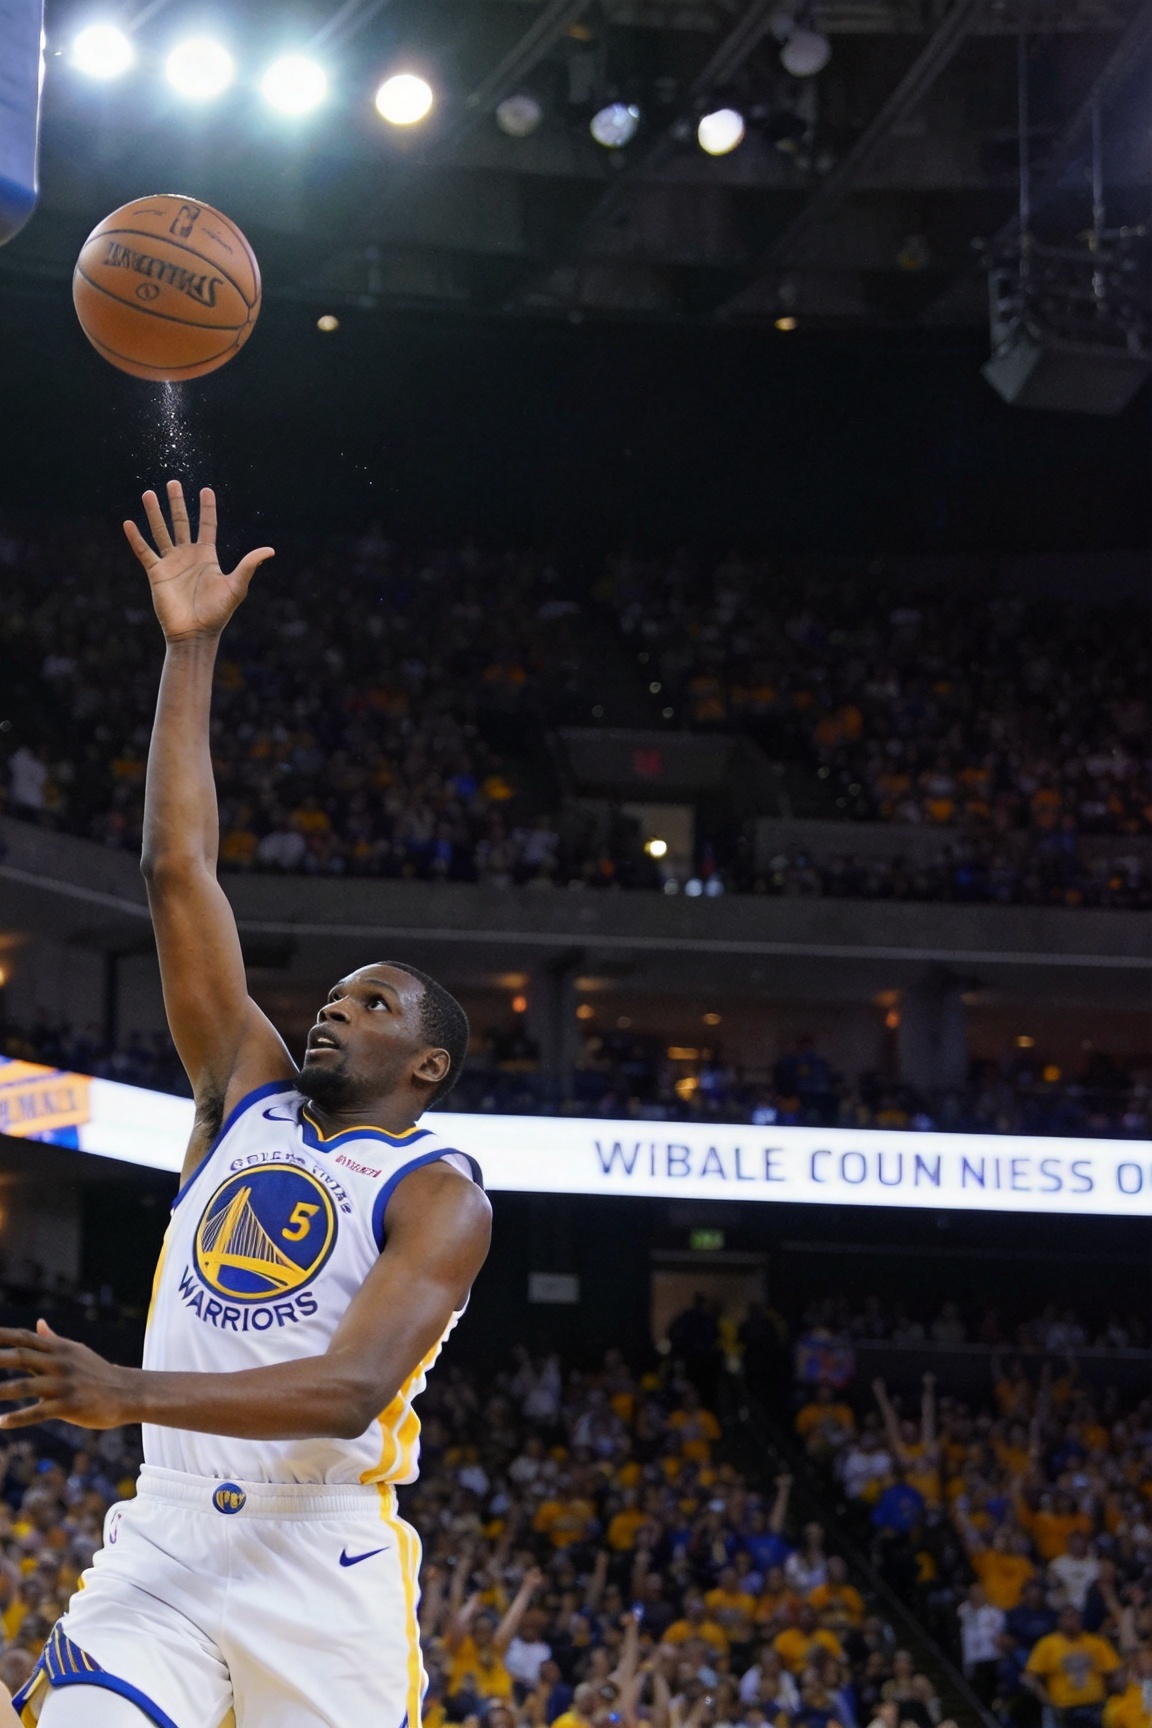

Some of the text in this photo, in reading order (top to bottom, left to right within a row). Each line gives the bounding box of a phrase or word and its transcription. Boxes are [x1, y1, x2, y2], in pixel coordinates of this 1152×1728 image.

[595, 1141, 786, 1182] WIBALE
[281, 1201, 320, 1242] 5
[178, 1264, 318, 1332] WARRIORS
